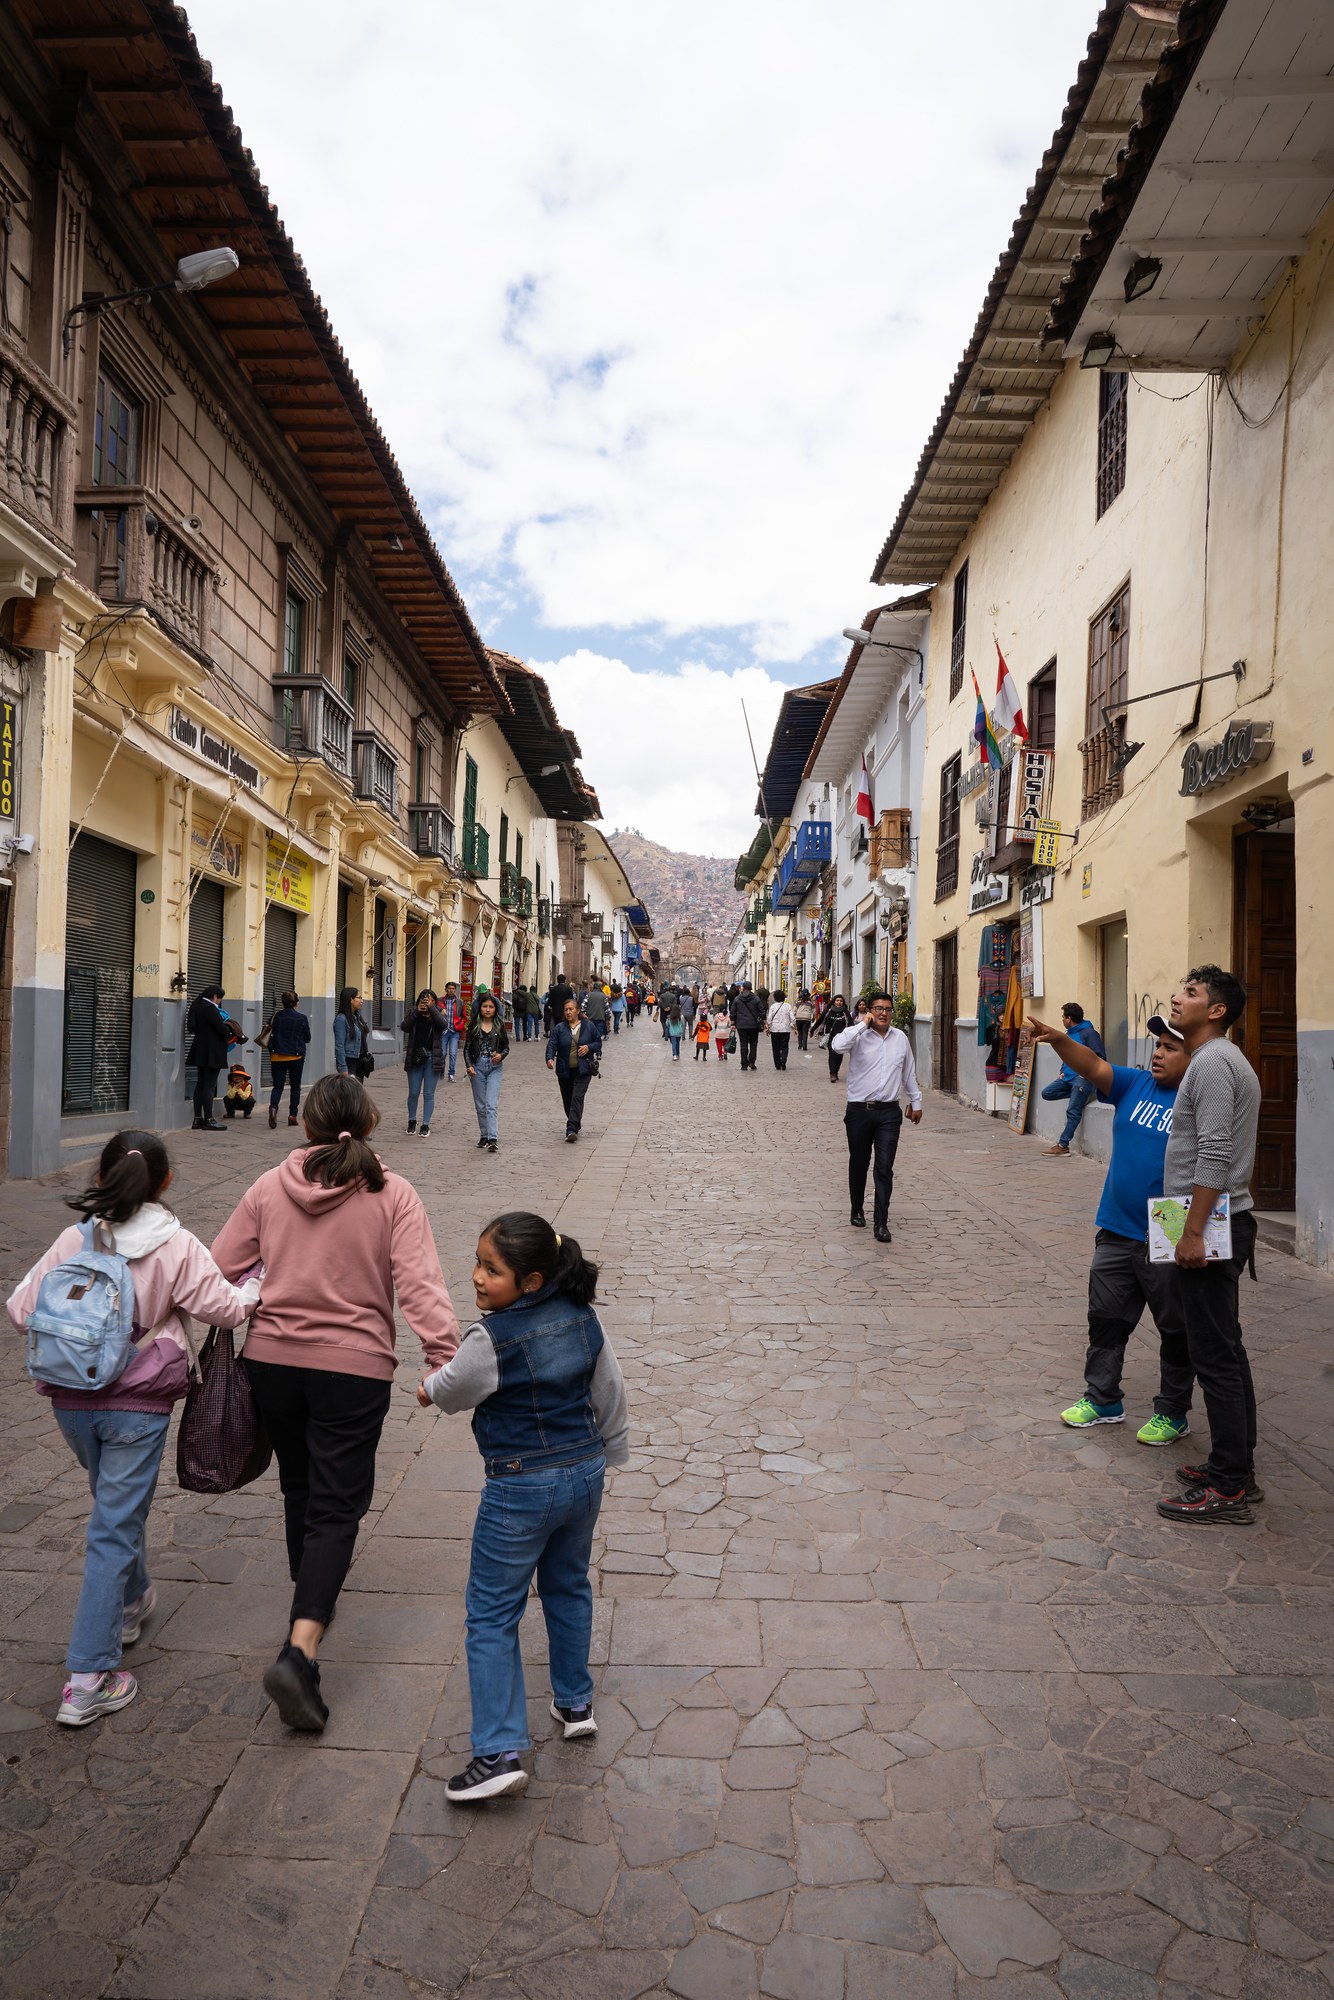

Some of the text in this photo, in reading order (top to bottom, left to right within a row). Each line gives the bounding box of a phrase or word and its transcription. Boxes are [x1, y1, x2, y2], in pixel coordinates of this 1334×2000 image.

[1, 703, 12, 815] TATTOO
[175, 709, 197, 750] Centro
[1178, 720, 1256, 797] Bata
[1021, 753, 1045, 830] HOSTAL
[1046, 832, 1055, 864] EUROS
[385, 923, 396, 997] Ojeda
